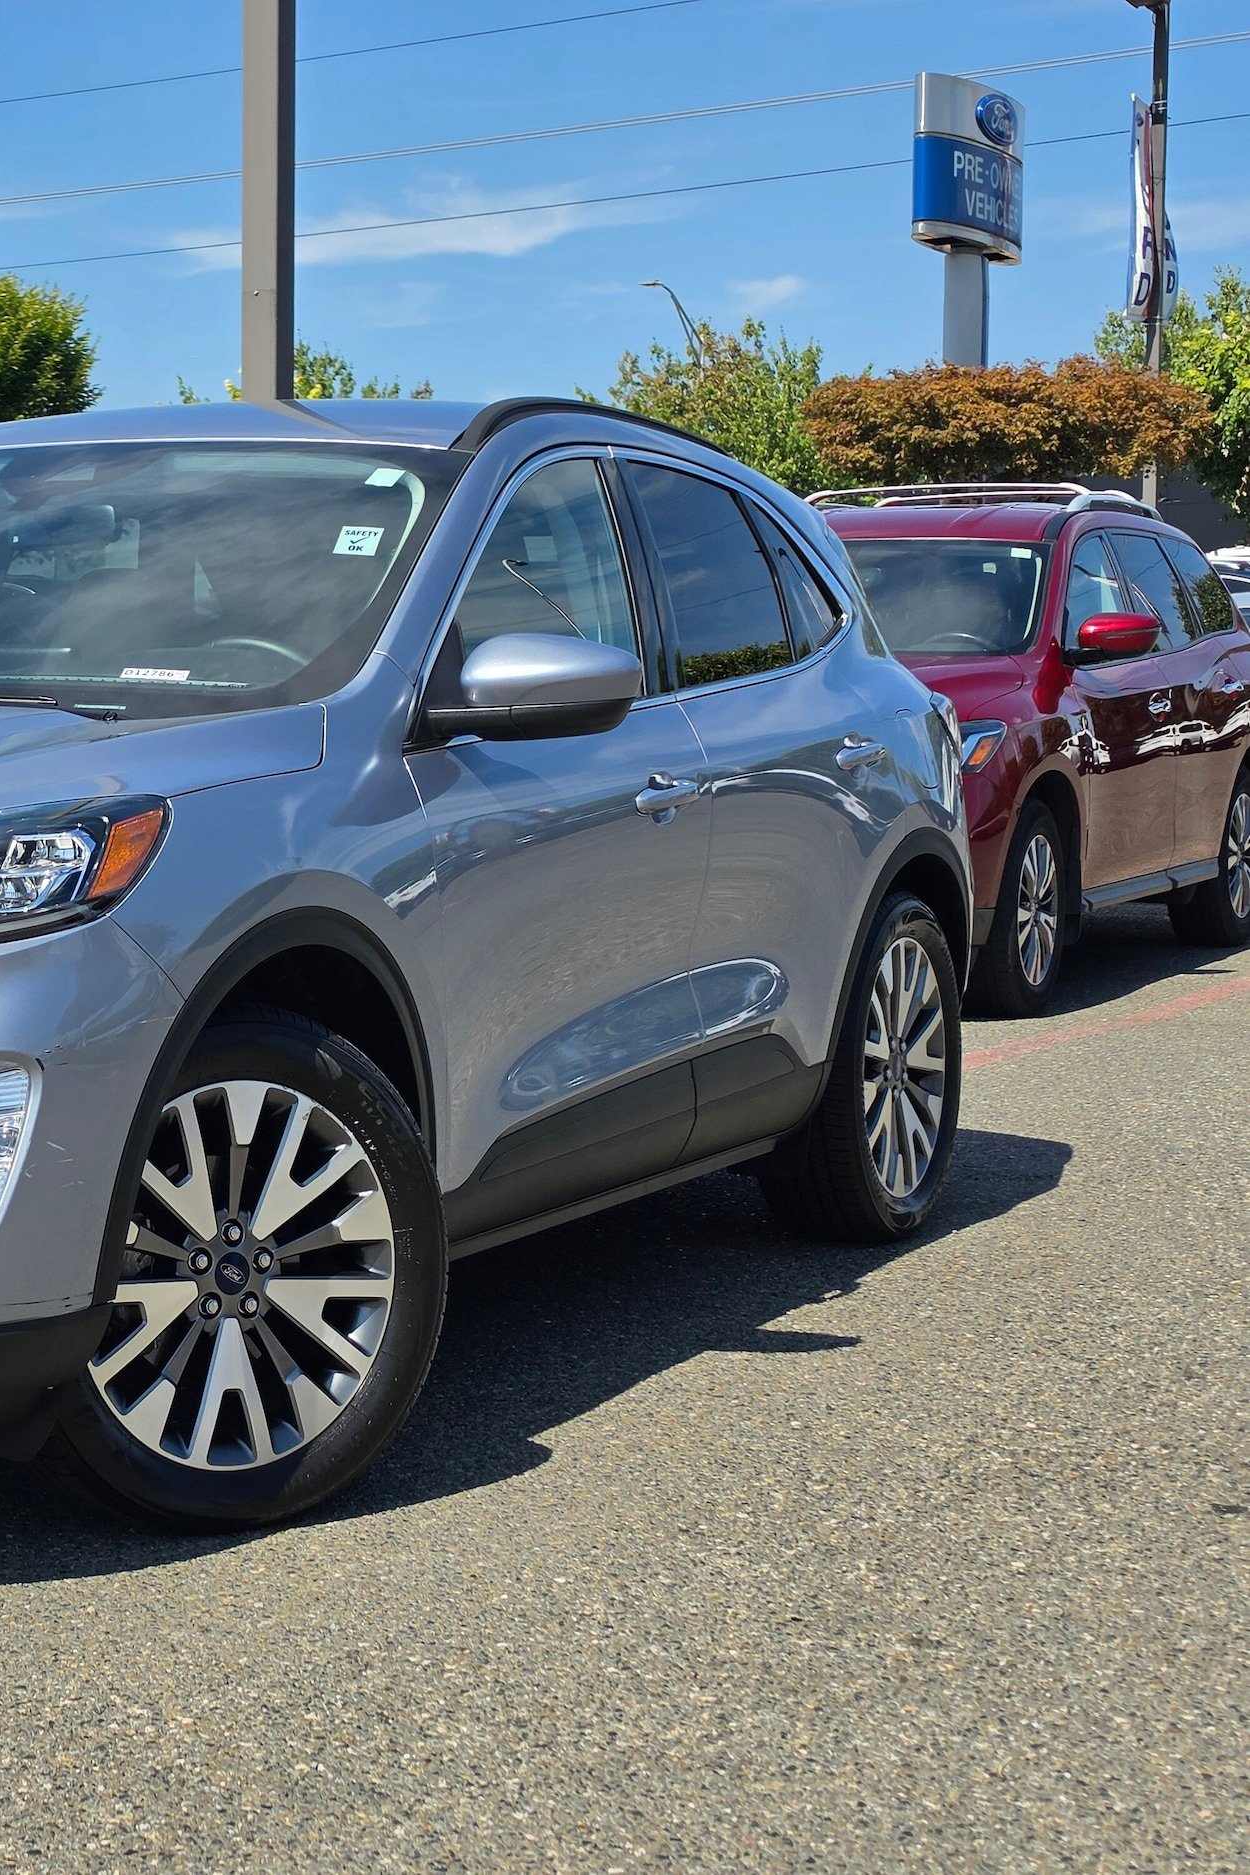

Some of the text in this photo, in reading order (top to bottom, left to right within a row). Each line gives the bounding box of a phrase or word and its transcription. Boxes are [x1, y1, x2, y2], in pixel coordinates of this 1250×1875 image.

[991, 103, 1014, 135] Ford
[953, 150, 1022, 201] PRE-OWNE
[964, 188, 1020, 233] VEHICLES
[124, 669, 174, 678] D12786
